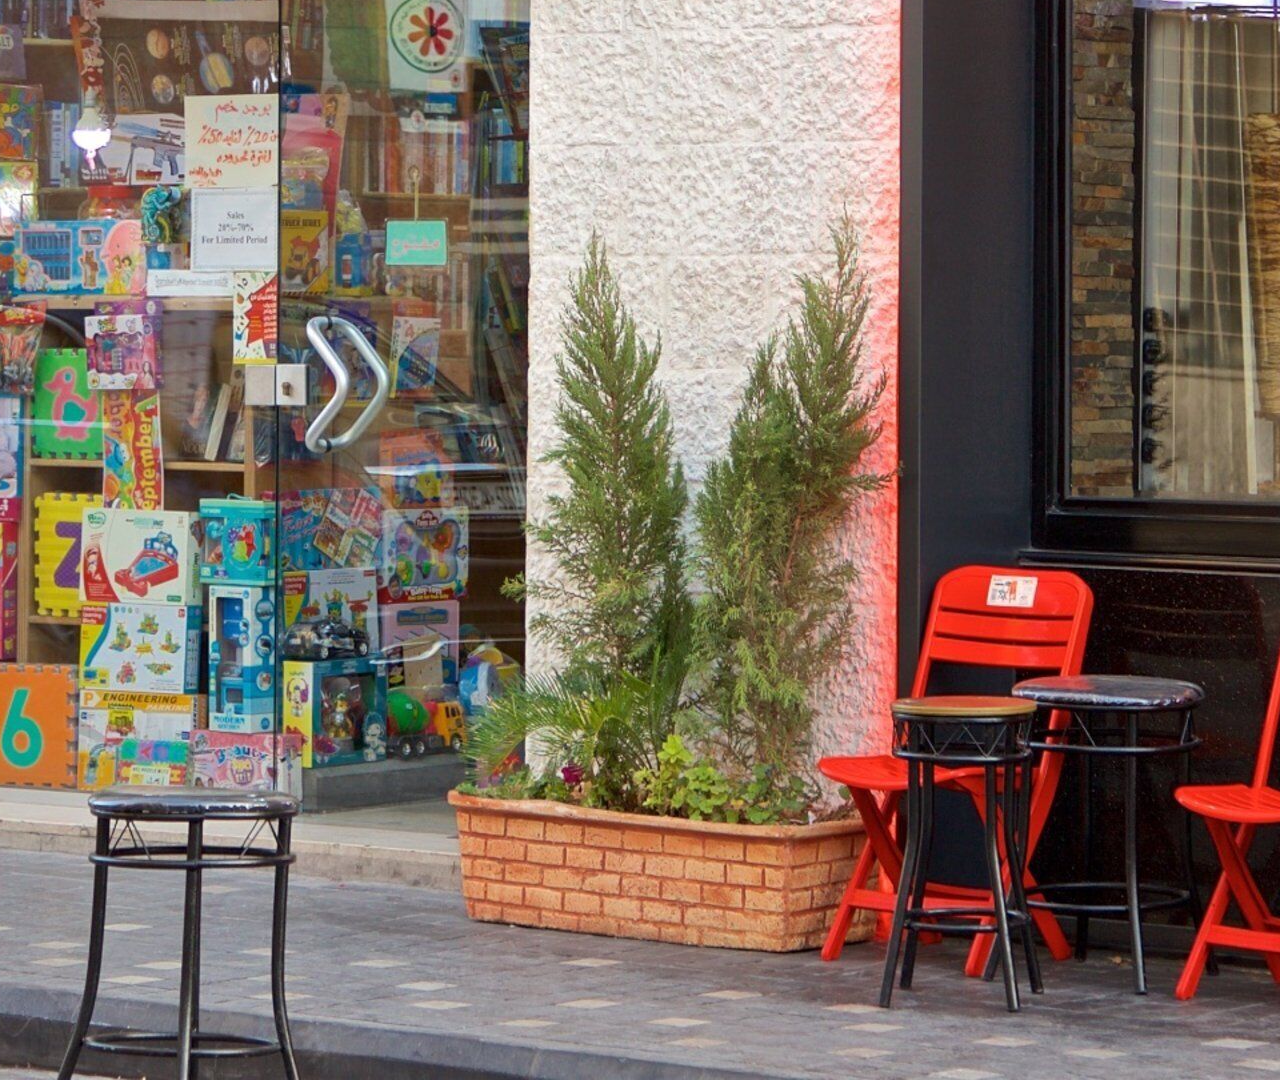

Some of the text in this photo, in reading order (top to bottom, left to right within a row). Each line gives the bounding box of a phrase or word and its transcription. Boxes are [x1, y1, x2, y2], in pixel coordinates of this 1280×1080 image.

[227, 211, 245, 220] Sales
[202, 236, 268, 244] For Limited Period
[135, 411, 158, 510] eptember
[103, 693, 177, 705] ENGINEERING
[0, 688, 43, 768] 6
